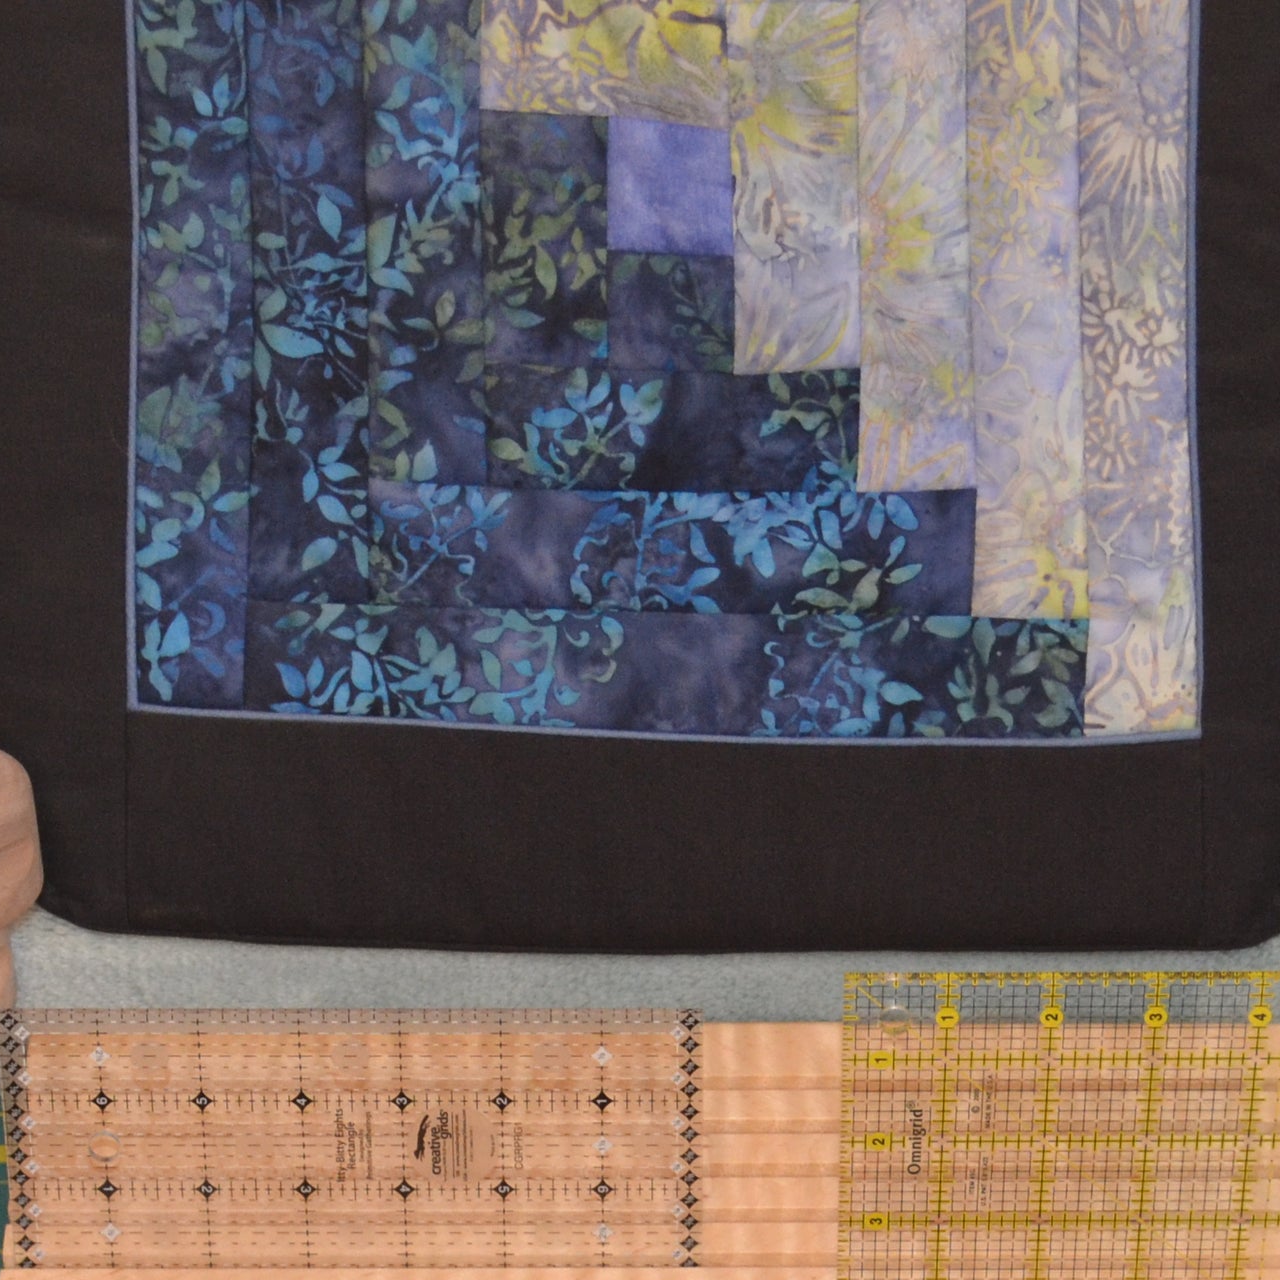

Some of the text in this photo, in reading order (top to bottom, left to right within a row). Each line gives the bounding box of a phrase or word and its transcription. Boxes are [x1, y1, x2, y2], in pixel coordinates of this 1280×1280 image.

[196, 1096, 207, 1106] 5
[295, 1096, 307, 1106] 4
[396, 1096, 408, 1106] 3
[496, 1096, 508, 1106] 2
[334, 1108, 346, 1138] Eights
[346, 1121, 357, 1169] Rectangle
[428, 1127, 441, 1175] creative
[907, 1109, 926, 1175] Omnigrid
